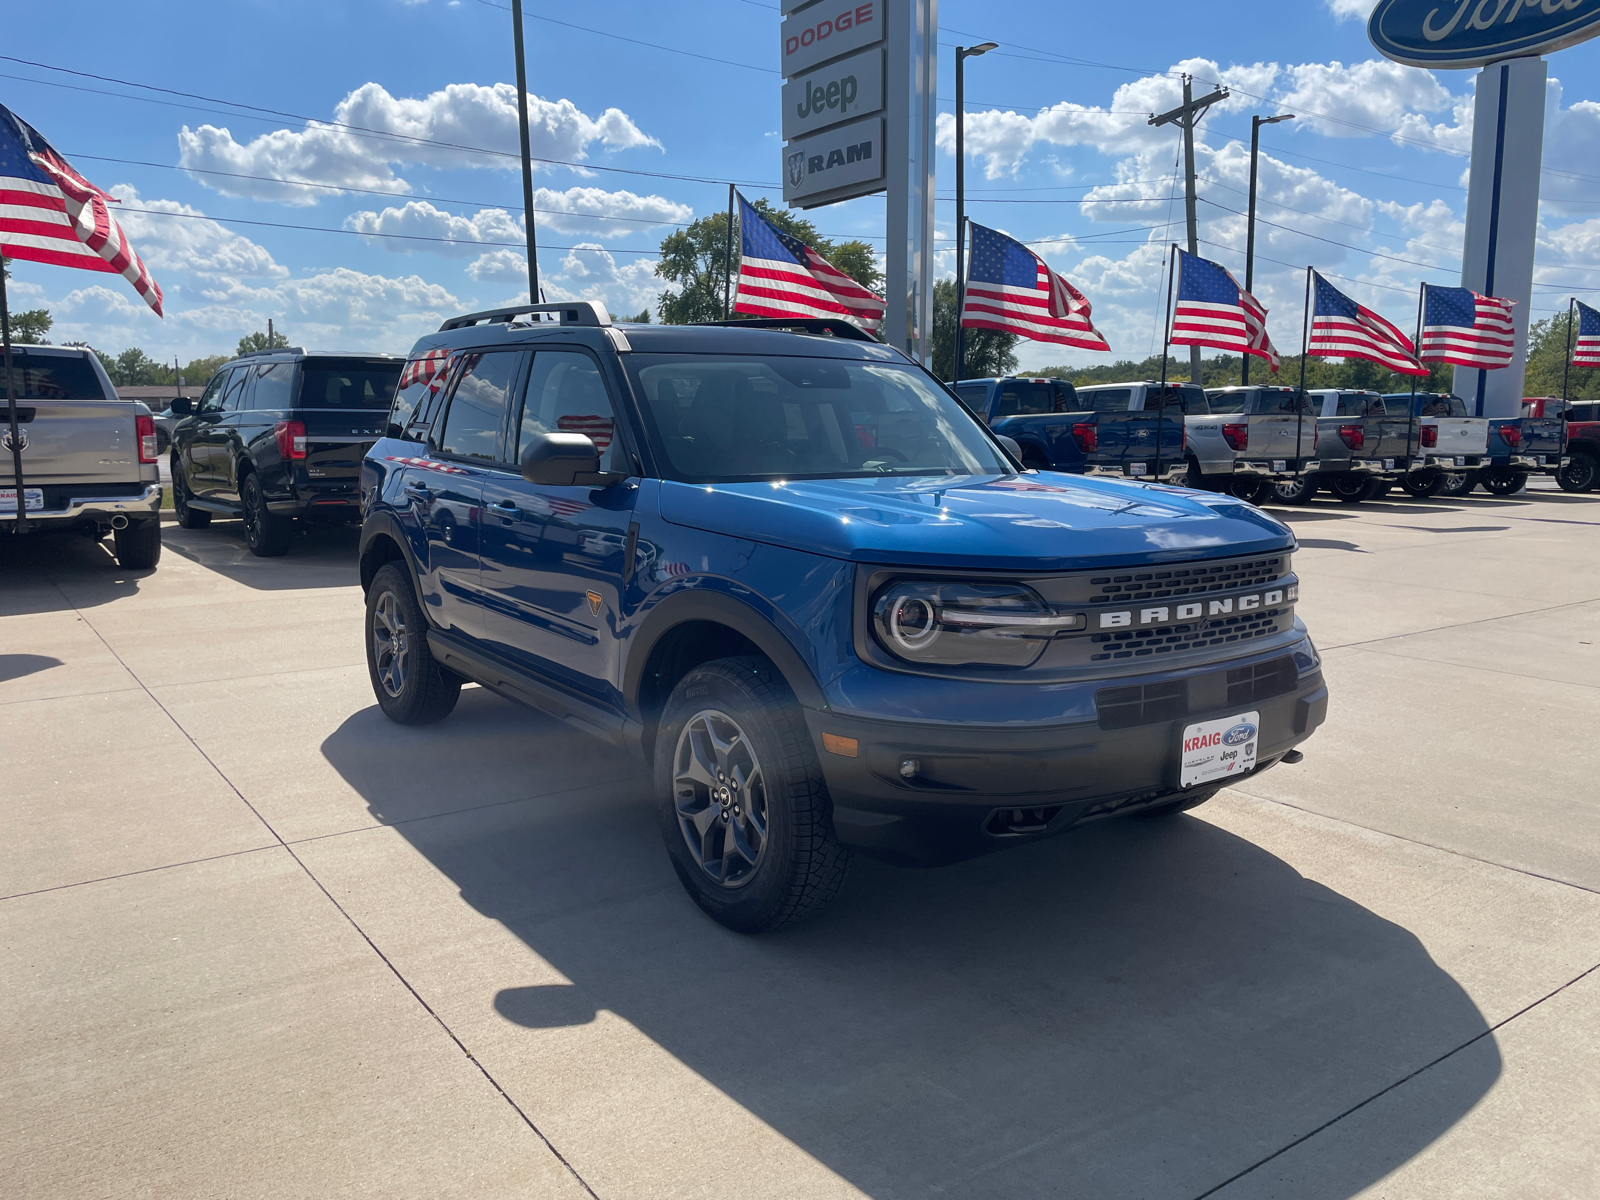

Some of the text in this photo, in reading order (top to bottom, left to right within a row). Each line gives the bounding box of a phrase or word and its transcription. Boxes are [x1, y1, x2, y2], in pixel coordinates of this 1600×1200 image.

[785, 2, 874, 56] DODGE
[797, 74, 858, 119] Jeep
[808, 140, 873, 175] RAM
[1099, 589, 1283, 628] BRONCO
[1184, 727, 1250, 753] KRAIG Ford
[1220, 750, 1238, 761] Jeep
